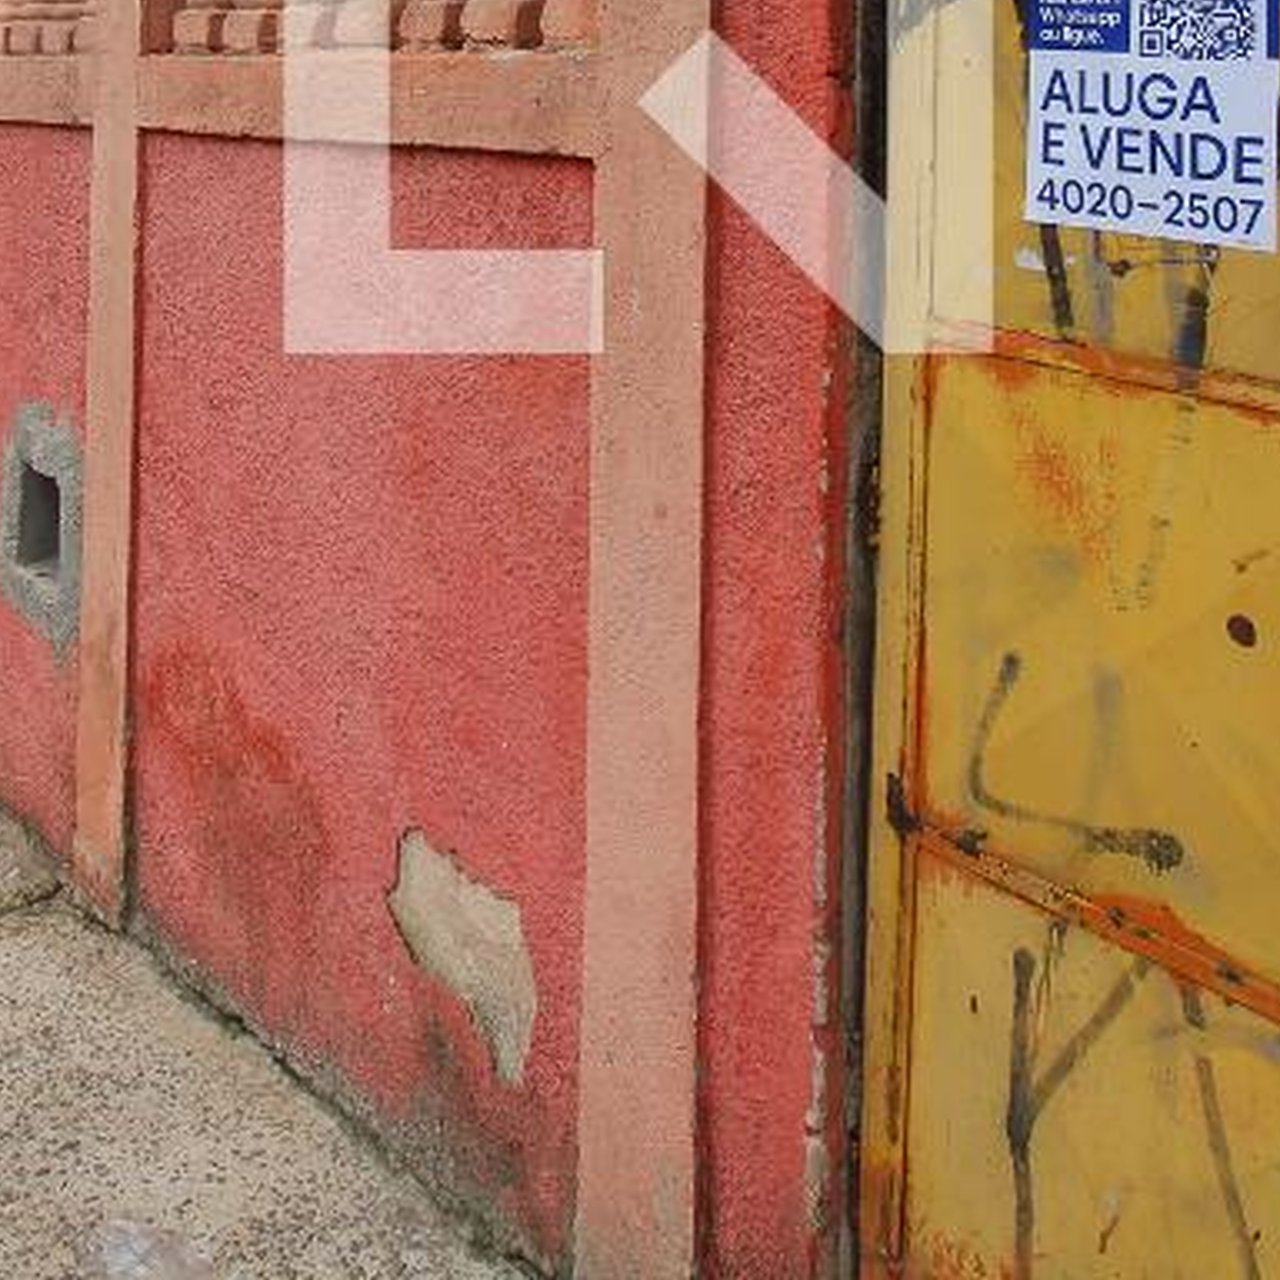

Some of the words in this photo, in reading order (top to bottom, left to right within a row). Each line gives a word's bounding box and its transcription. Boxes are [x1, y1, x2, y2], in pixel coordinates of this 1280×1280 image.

[1040, 69, 1221, 124] ALUGA
[1041, 122, 1066, 167] E
[1079, 124, 1265, 186] VENDE
[1036, 177, 1265, 236] 4020-2507
